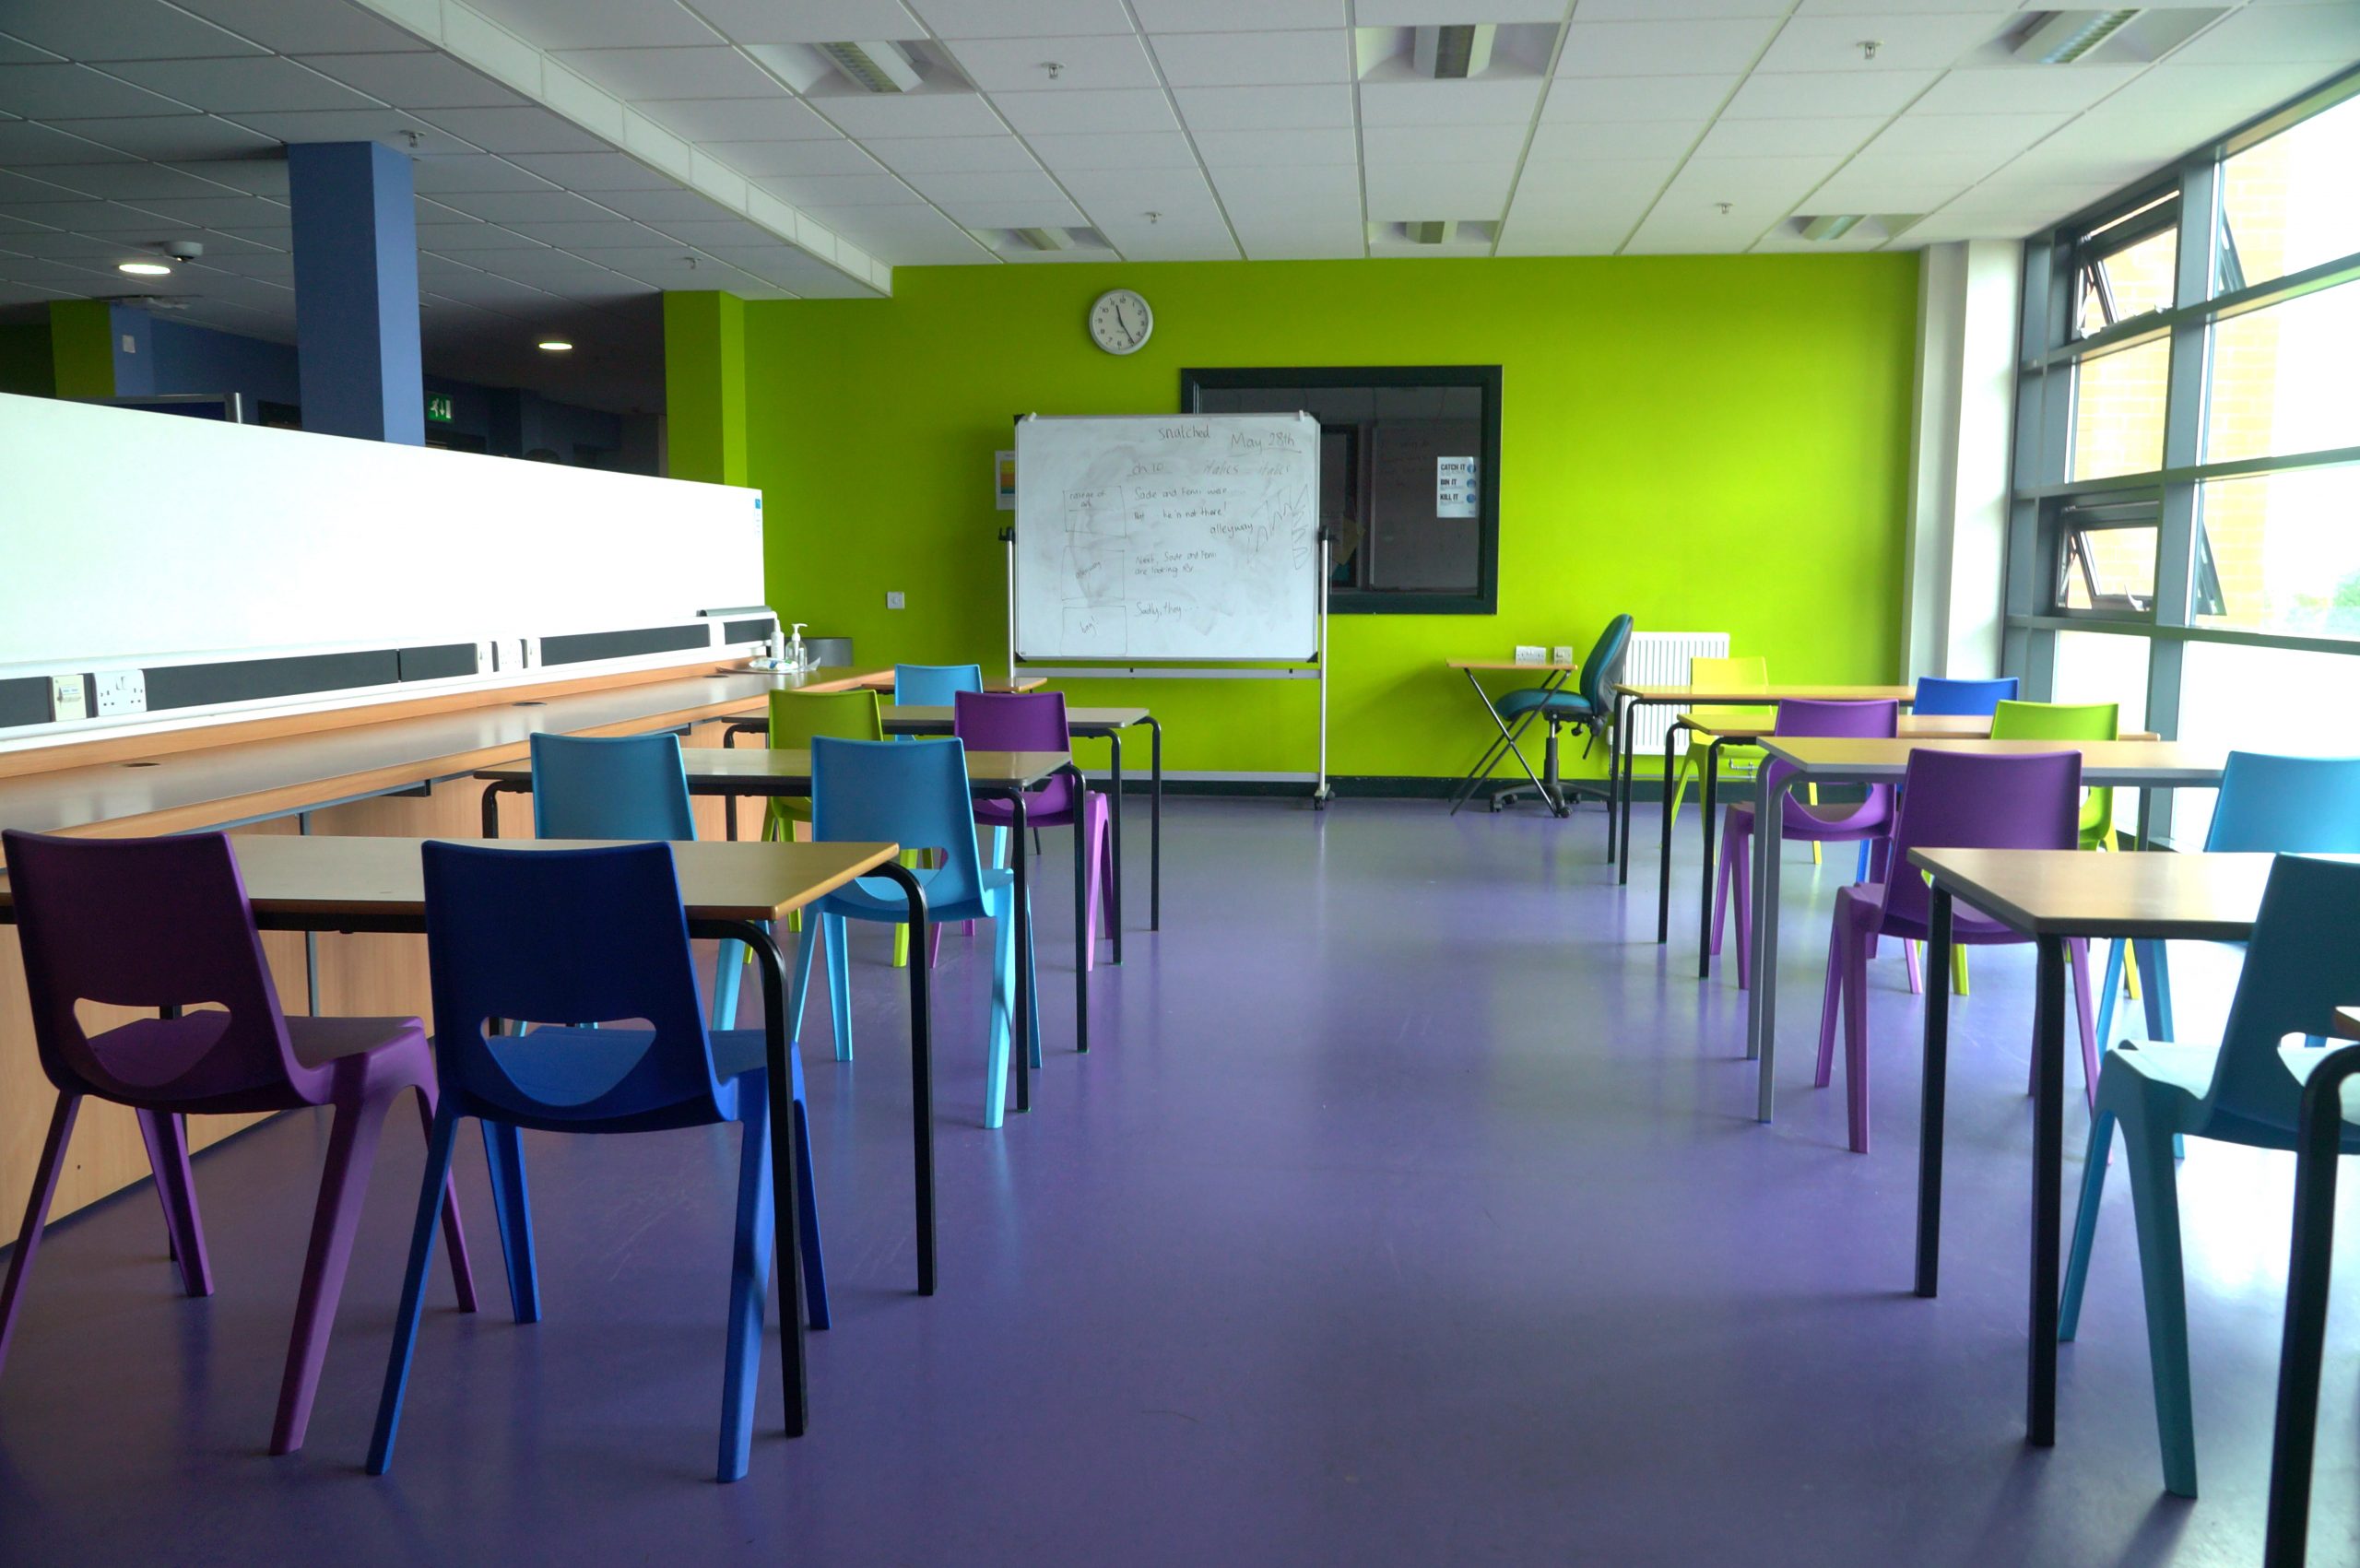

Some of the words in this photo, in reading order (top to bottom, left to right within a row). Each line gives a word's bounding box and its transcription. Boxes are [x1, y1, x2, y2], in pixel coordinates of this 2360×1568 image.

[1158, 424, 1210, 441] snatched
[1231, 433, 1263, 453] May
[1210, 520, 1254, 539] alleyway
